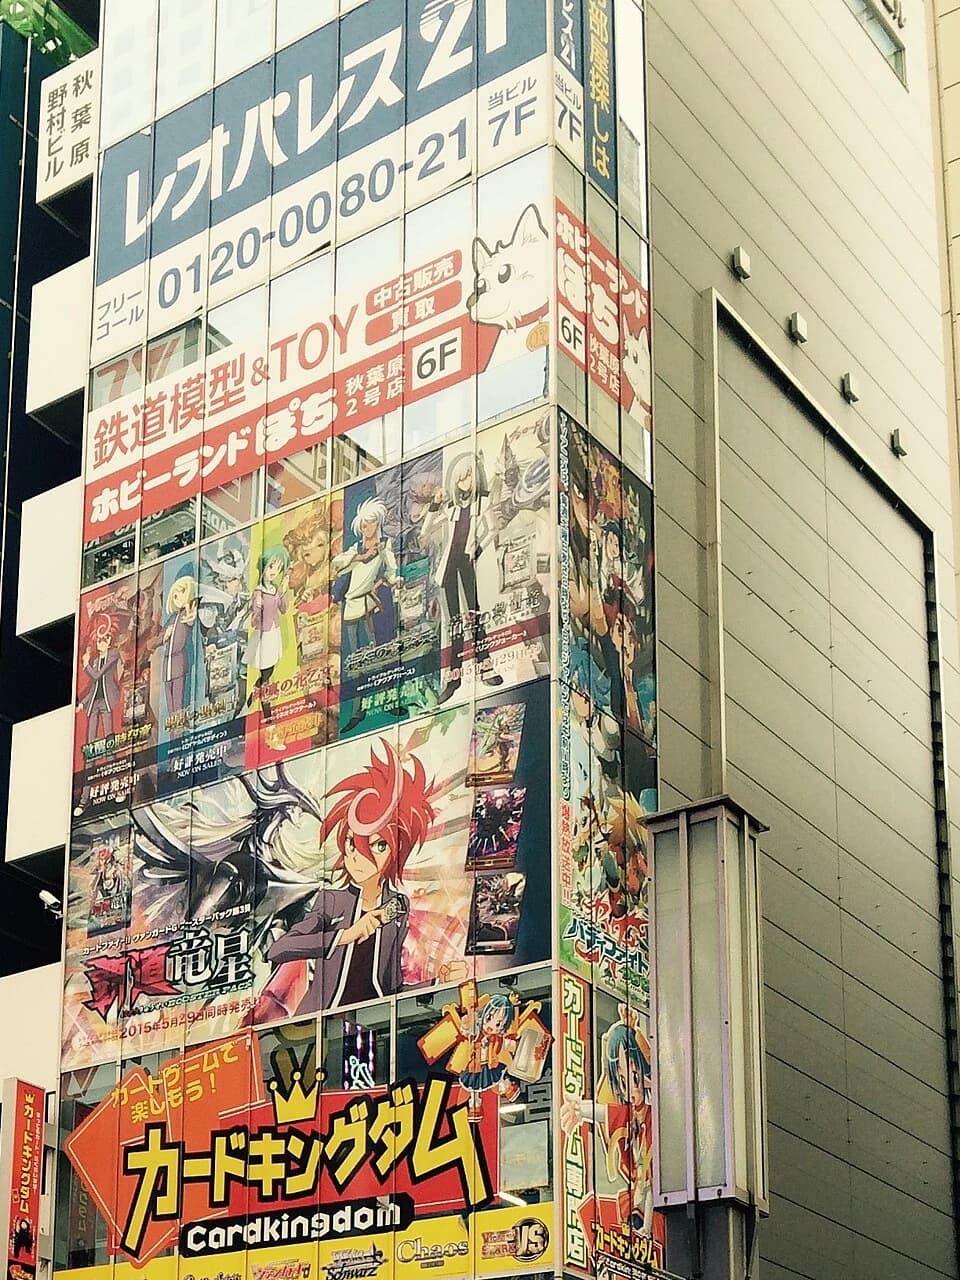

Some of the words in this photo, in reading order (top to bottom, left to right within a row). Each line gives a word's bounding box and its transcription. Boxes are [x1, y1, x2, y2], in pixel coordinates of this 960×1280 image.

[487, 74, 538, 112] 当ビル
[44, 82, 70, 183] 野村ビル
[70, 71, 96, 166] 秋葉原
[489, 99, 537, 148] 7F
[555, 95, 583, 143] 7F
[158, 115, 468, 310] 0120-0080-21
[96, 289, 143, 321] フリー
[372, 257, 457, 310] 中古販売
[96, 308, 145, 342] コール
[391, 298, 436, 332] 買取
[560, 314, 583, 352] 6F
[345, 355, 405, 398] 秋葉原
[417, 339, 458, 382] 6F
[345, 380, 404, 420] 2号店
[91, 430, 250, 524] ホビーランド
[111, 1039, 240, 1108] カードゲームで
[120, 1077, 490, 1259] カードキングダム
[187, 1200, 401, 1252] Cardkingdom
[396, 1237, 469, 1263] Chaos
